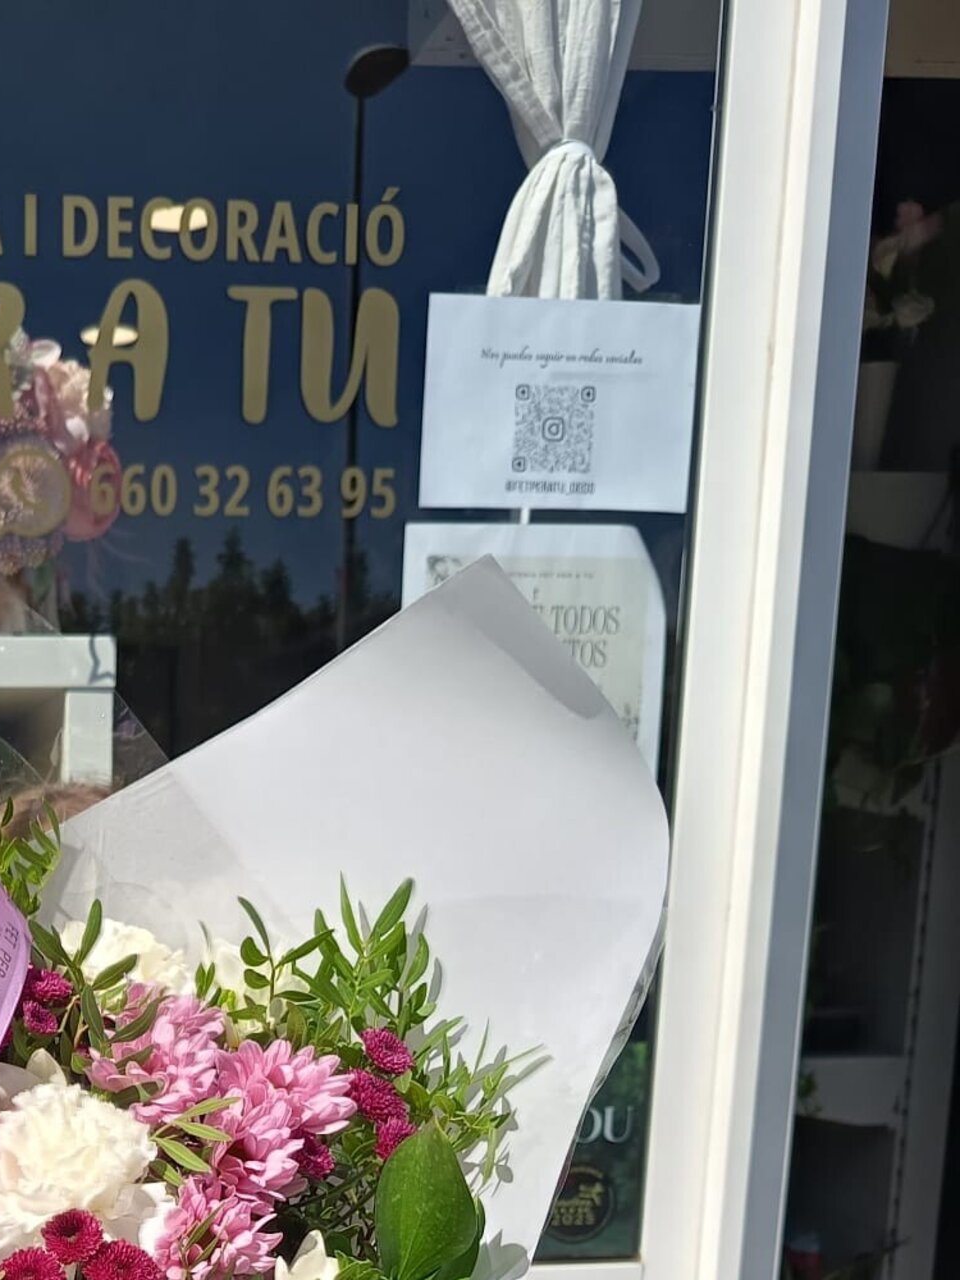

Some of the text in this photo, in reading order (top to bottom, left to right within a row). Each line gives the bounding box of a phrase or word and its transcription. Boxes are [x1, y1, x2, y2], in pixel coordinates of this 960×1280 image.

[24, 194, 38, 257] I
[62, 187, 406, 266] DECORACIÓ
[87, 278, 171, 423] A
[226, 284, 400, 428] TU
[90, 464, 397, 520] 660 32 63 95
[550, 604, 620, 635] TODOS
[562, 639, 607, 668] TOS
[5, 922, 19, 949] FET
[577, 1106, 634, 1143] OU
